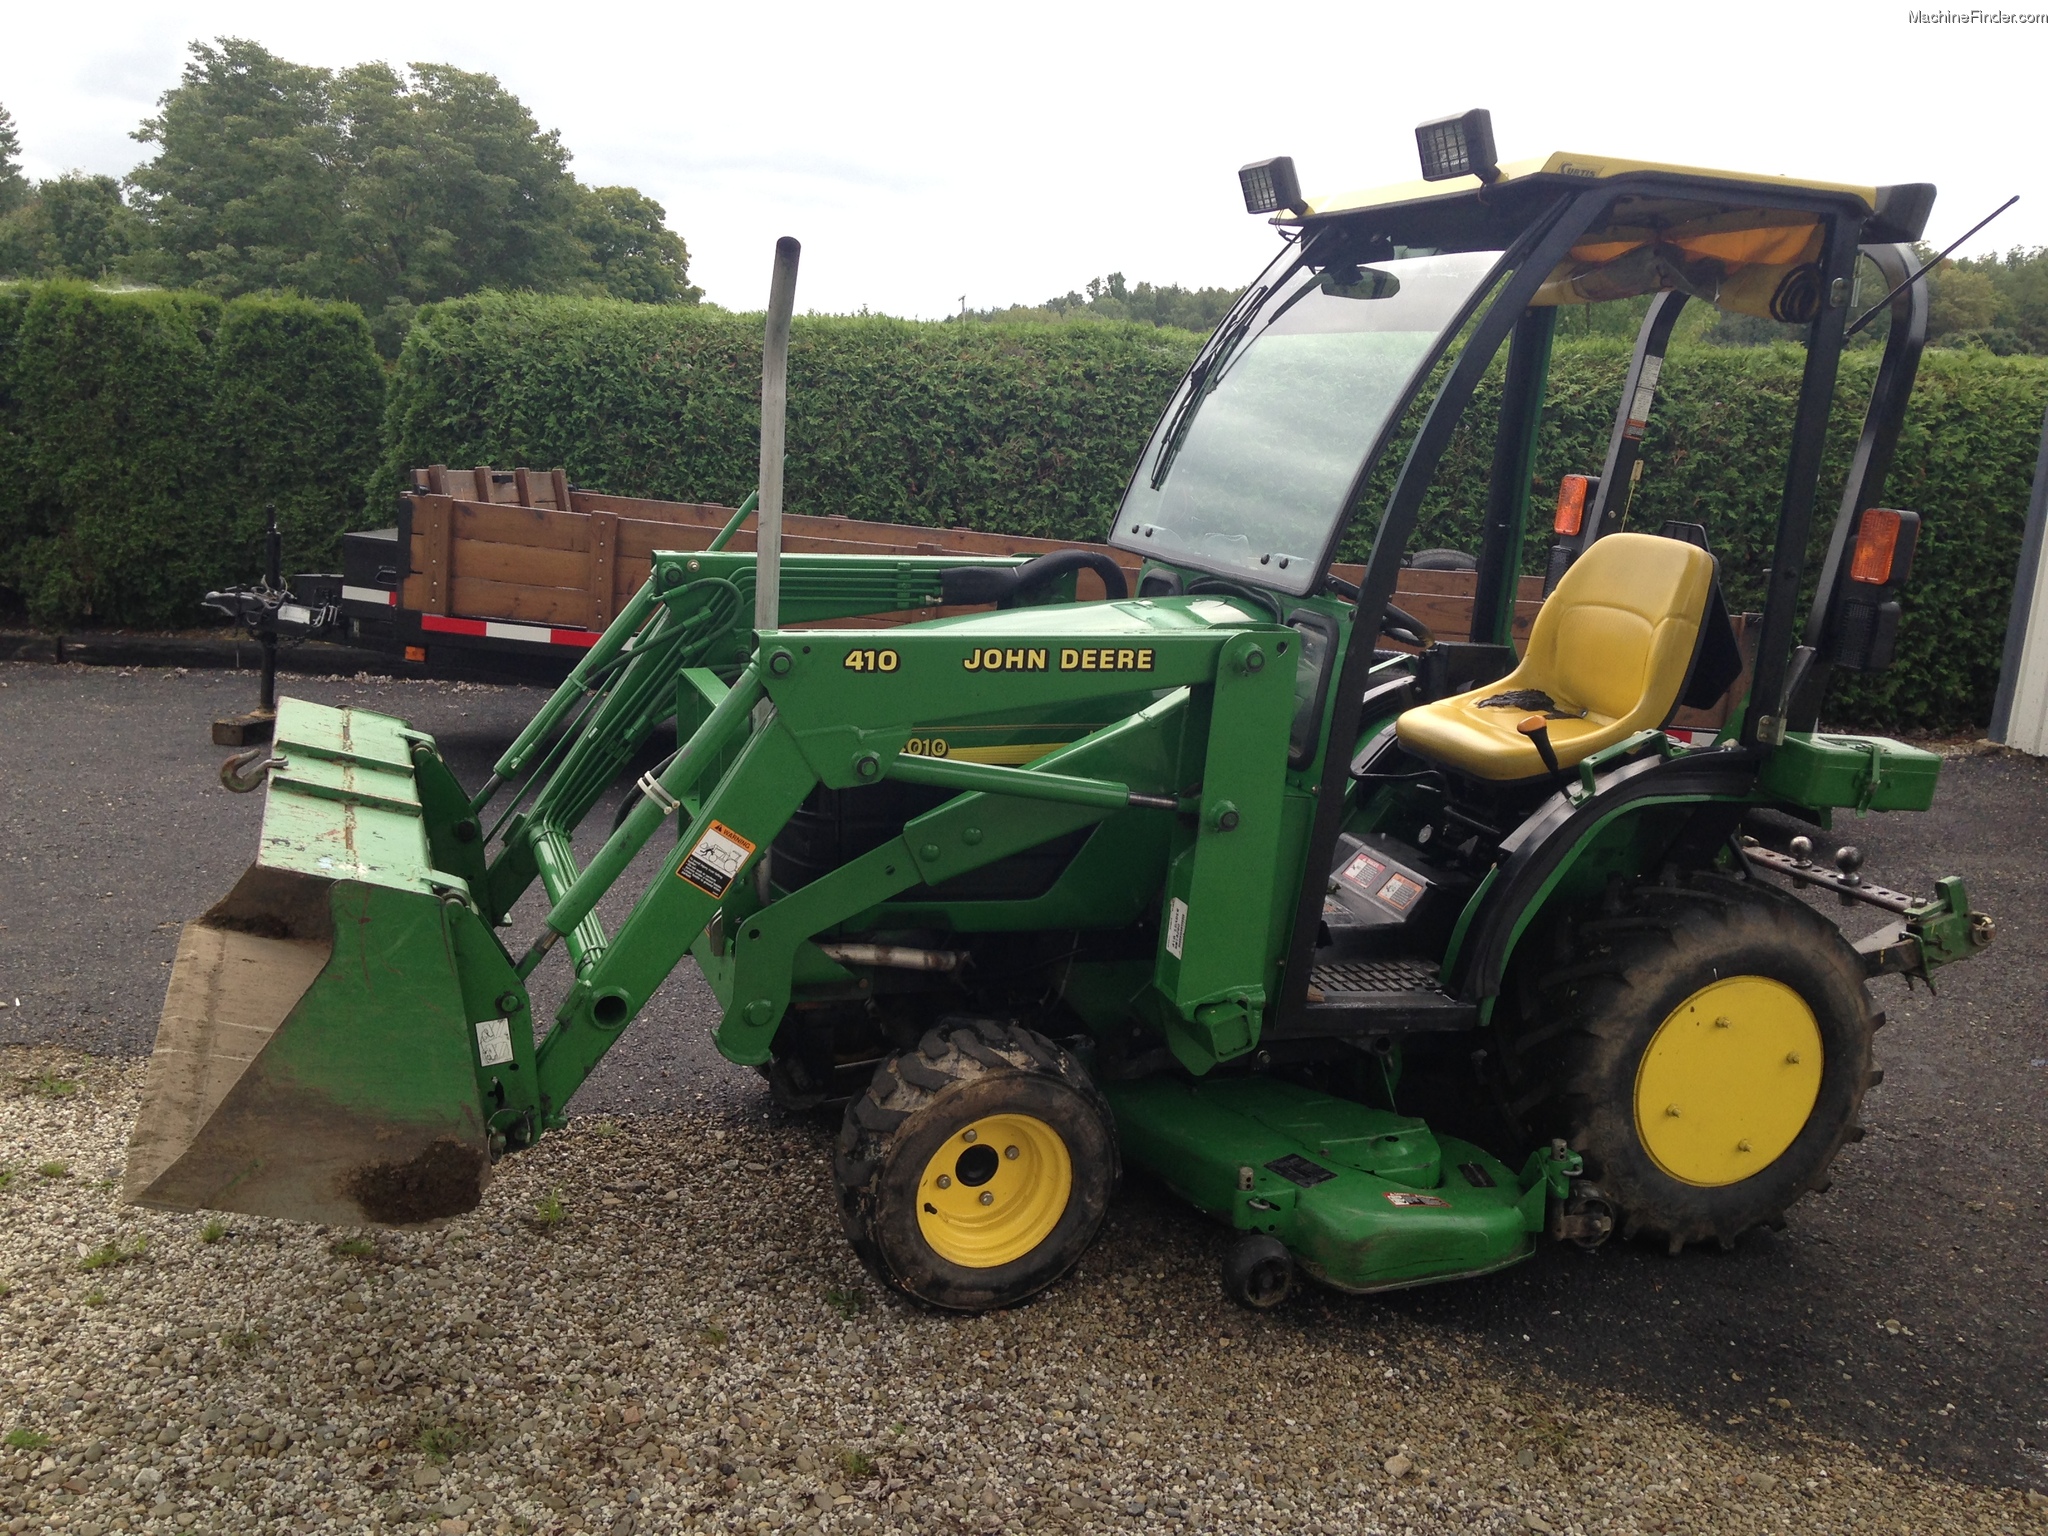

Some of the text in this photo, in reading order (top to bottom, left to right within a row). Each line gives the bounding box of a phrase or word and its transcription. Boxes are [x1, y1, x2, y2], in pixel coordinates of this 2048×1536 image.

[843, 649, 900, 673] 410
[963, 648, 1156, 672] JOHN DEERE
[901, 738, 949, 758] 010
[723, 828, 751, 849] WARNING
